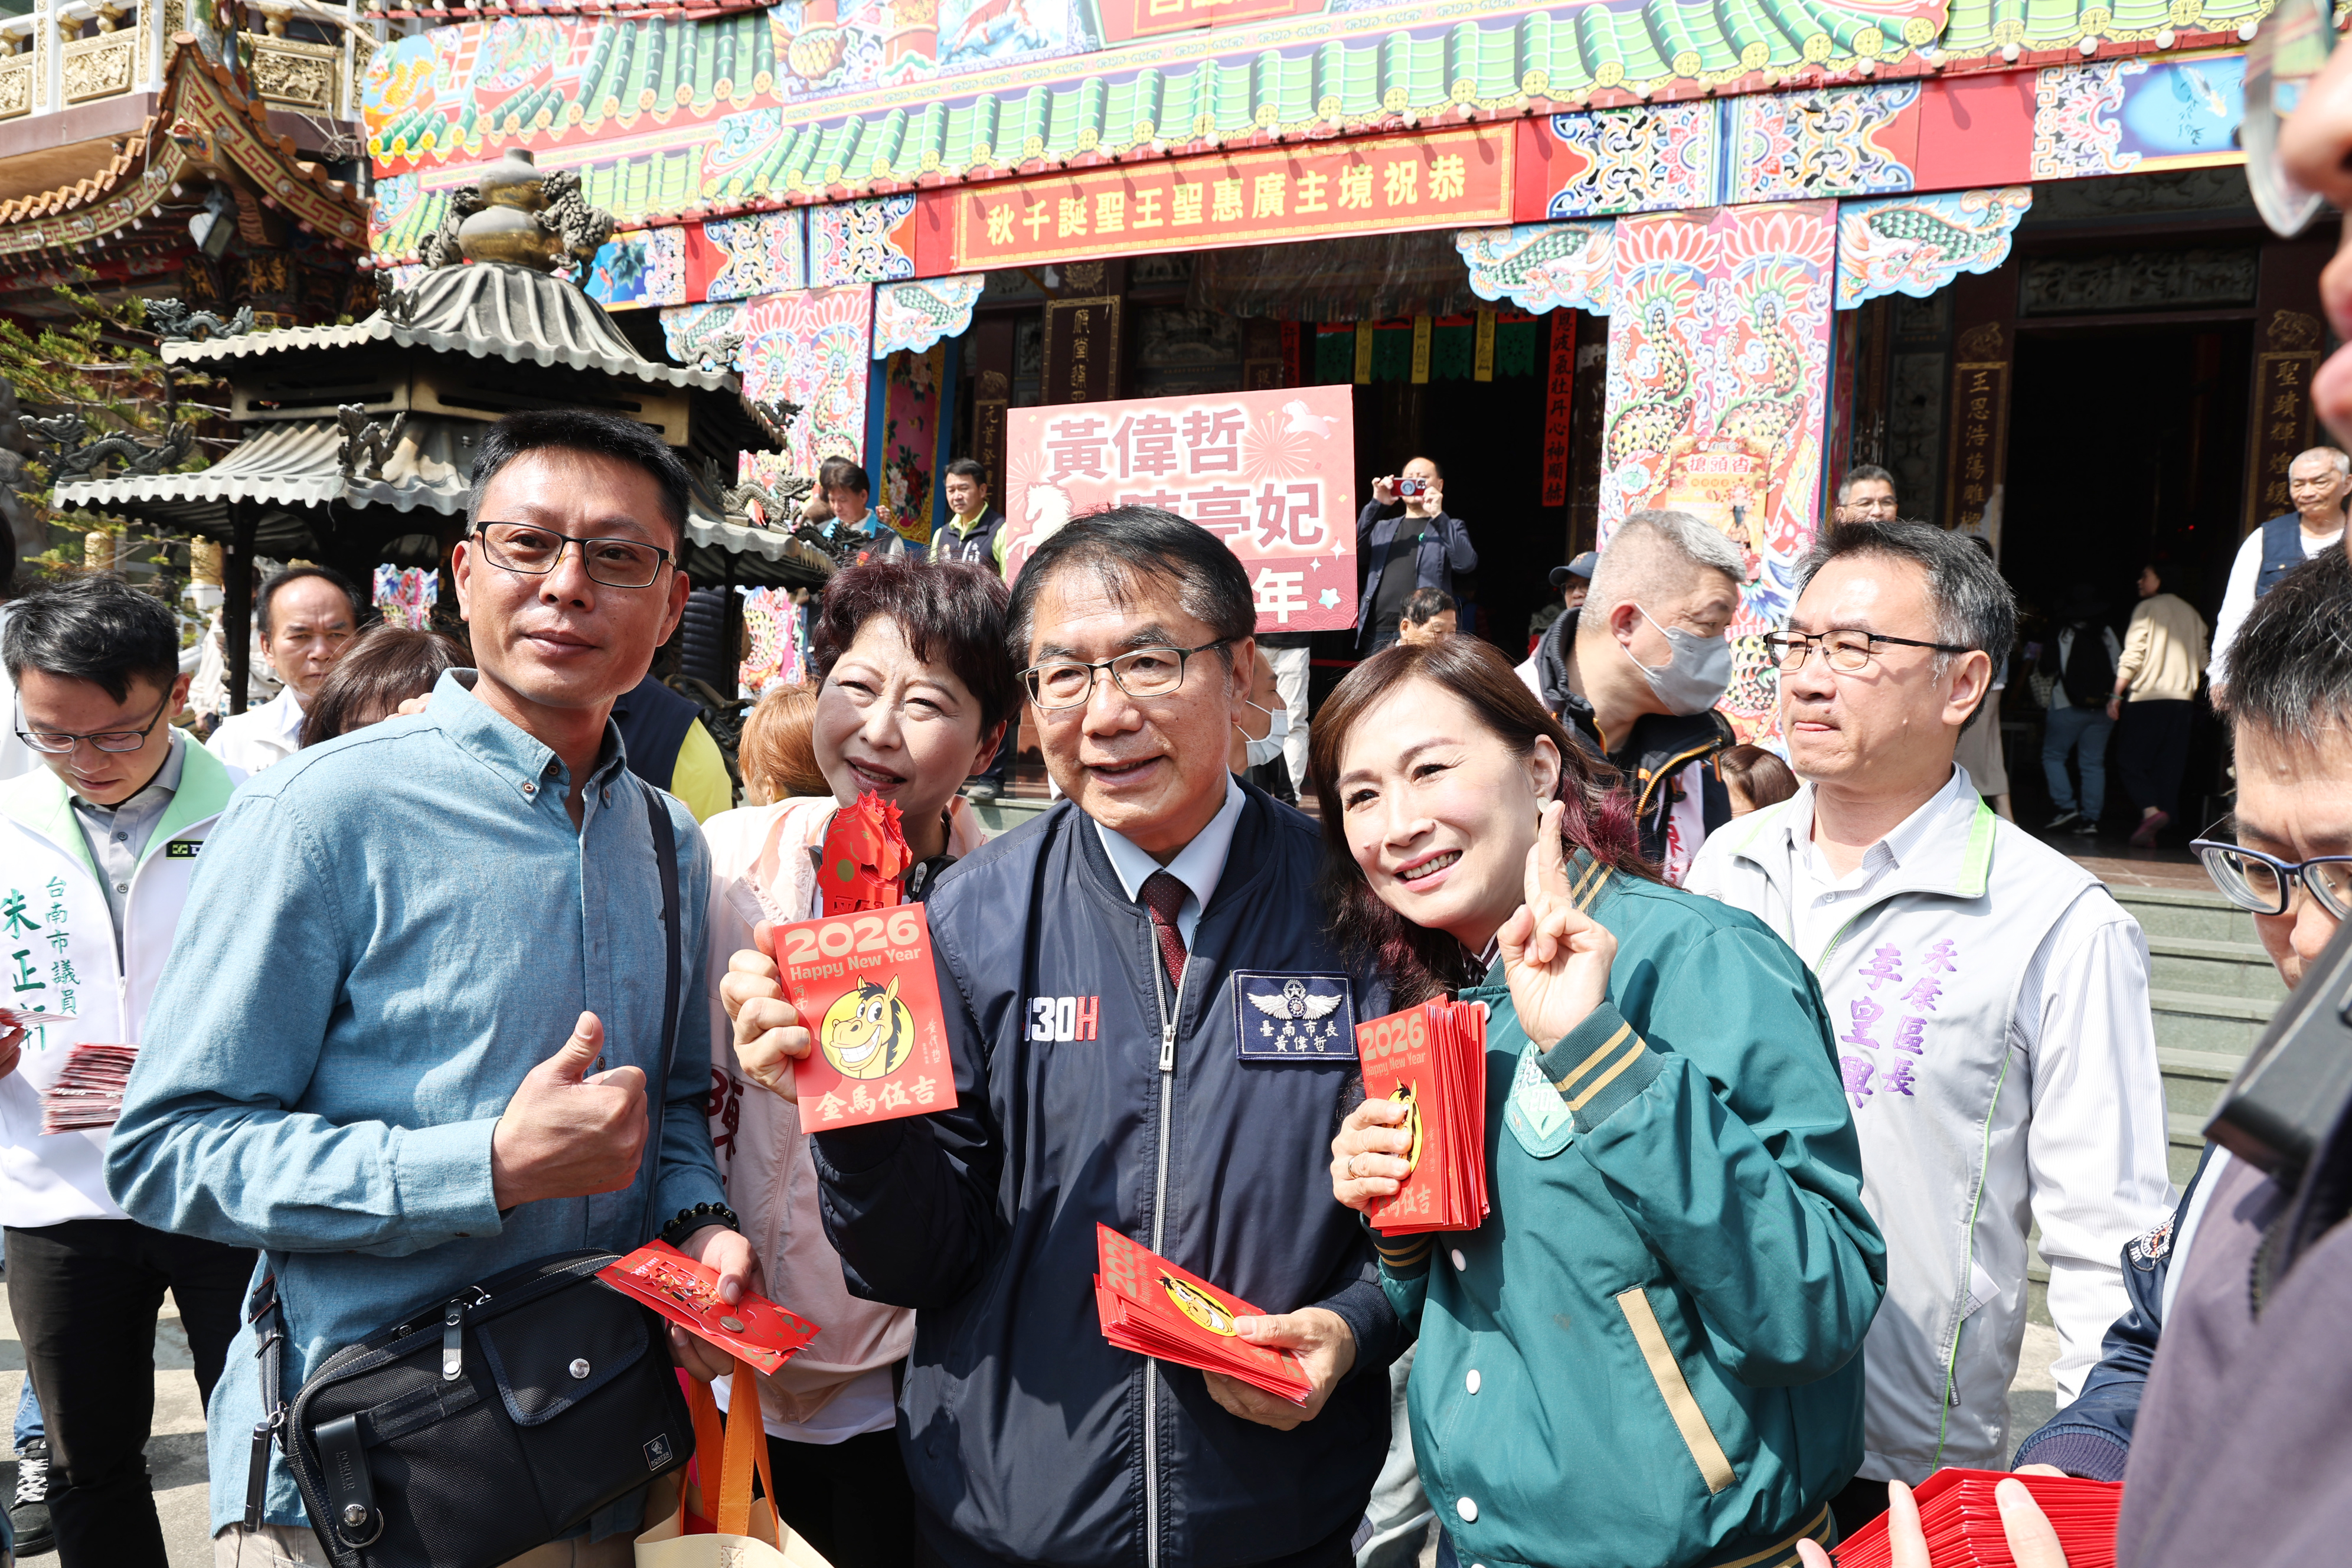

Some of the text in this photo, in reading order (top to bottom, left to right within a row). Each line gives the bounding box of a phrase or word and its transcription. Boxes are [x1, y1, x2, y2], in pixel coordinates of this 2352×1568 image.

[1046, 408, 1245, 484] 黃偉哲
[45, 876, 80, 1015] 台南市議員
[785, 911, 920, 965] 2026
[790, 946, 921, 981] Happy New Year
[793, 985, 808, 1010] 丙午
[1260, 1020, 1339, 1037] 臺南市長
[1881, 938, 1958, 1096] 永康區長
[1275, 1034, 1327, 1052] 黃偉哲
[1360, 1013, 1425, 1061] 2026
[1365, 1051, 1426, 1079] Happy New Year
[815, 1076, 936, 1121] 金馬伍吉
[1105, 1230, 1137, 1298] 2026
[1137, 1262, 1149, 1278] New
[1139, 1279, 1154, 1305] Happy
[339, 1451, 355, 1490] PORTER
[651, 1452, 670, 1465] PORTER
